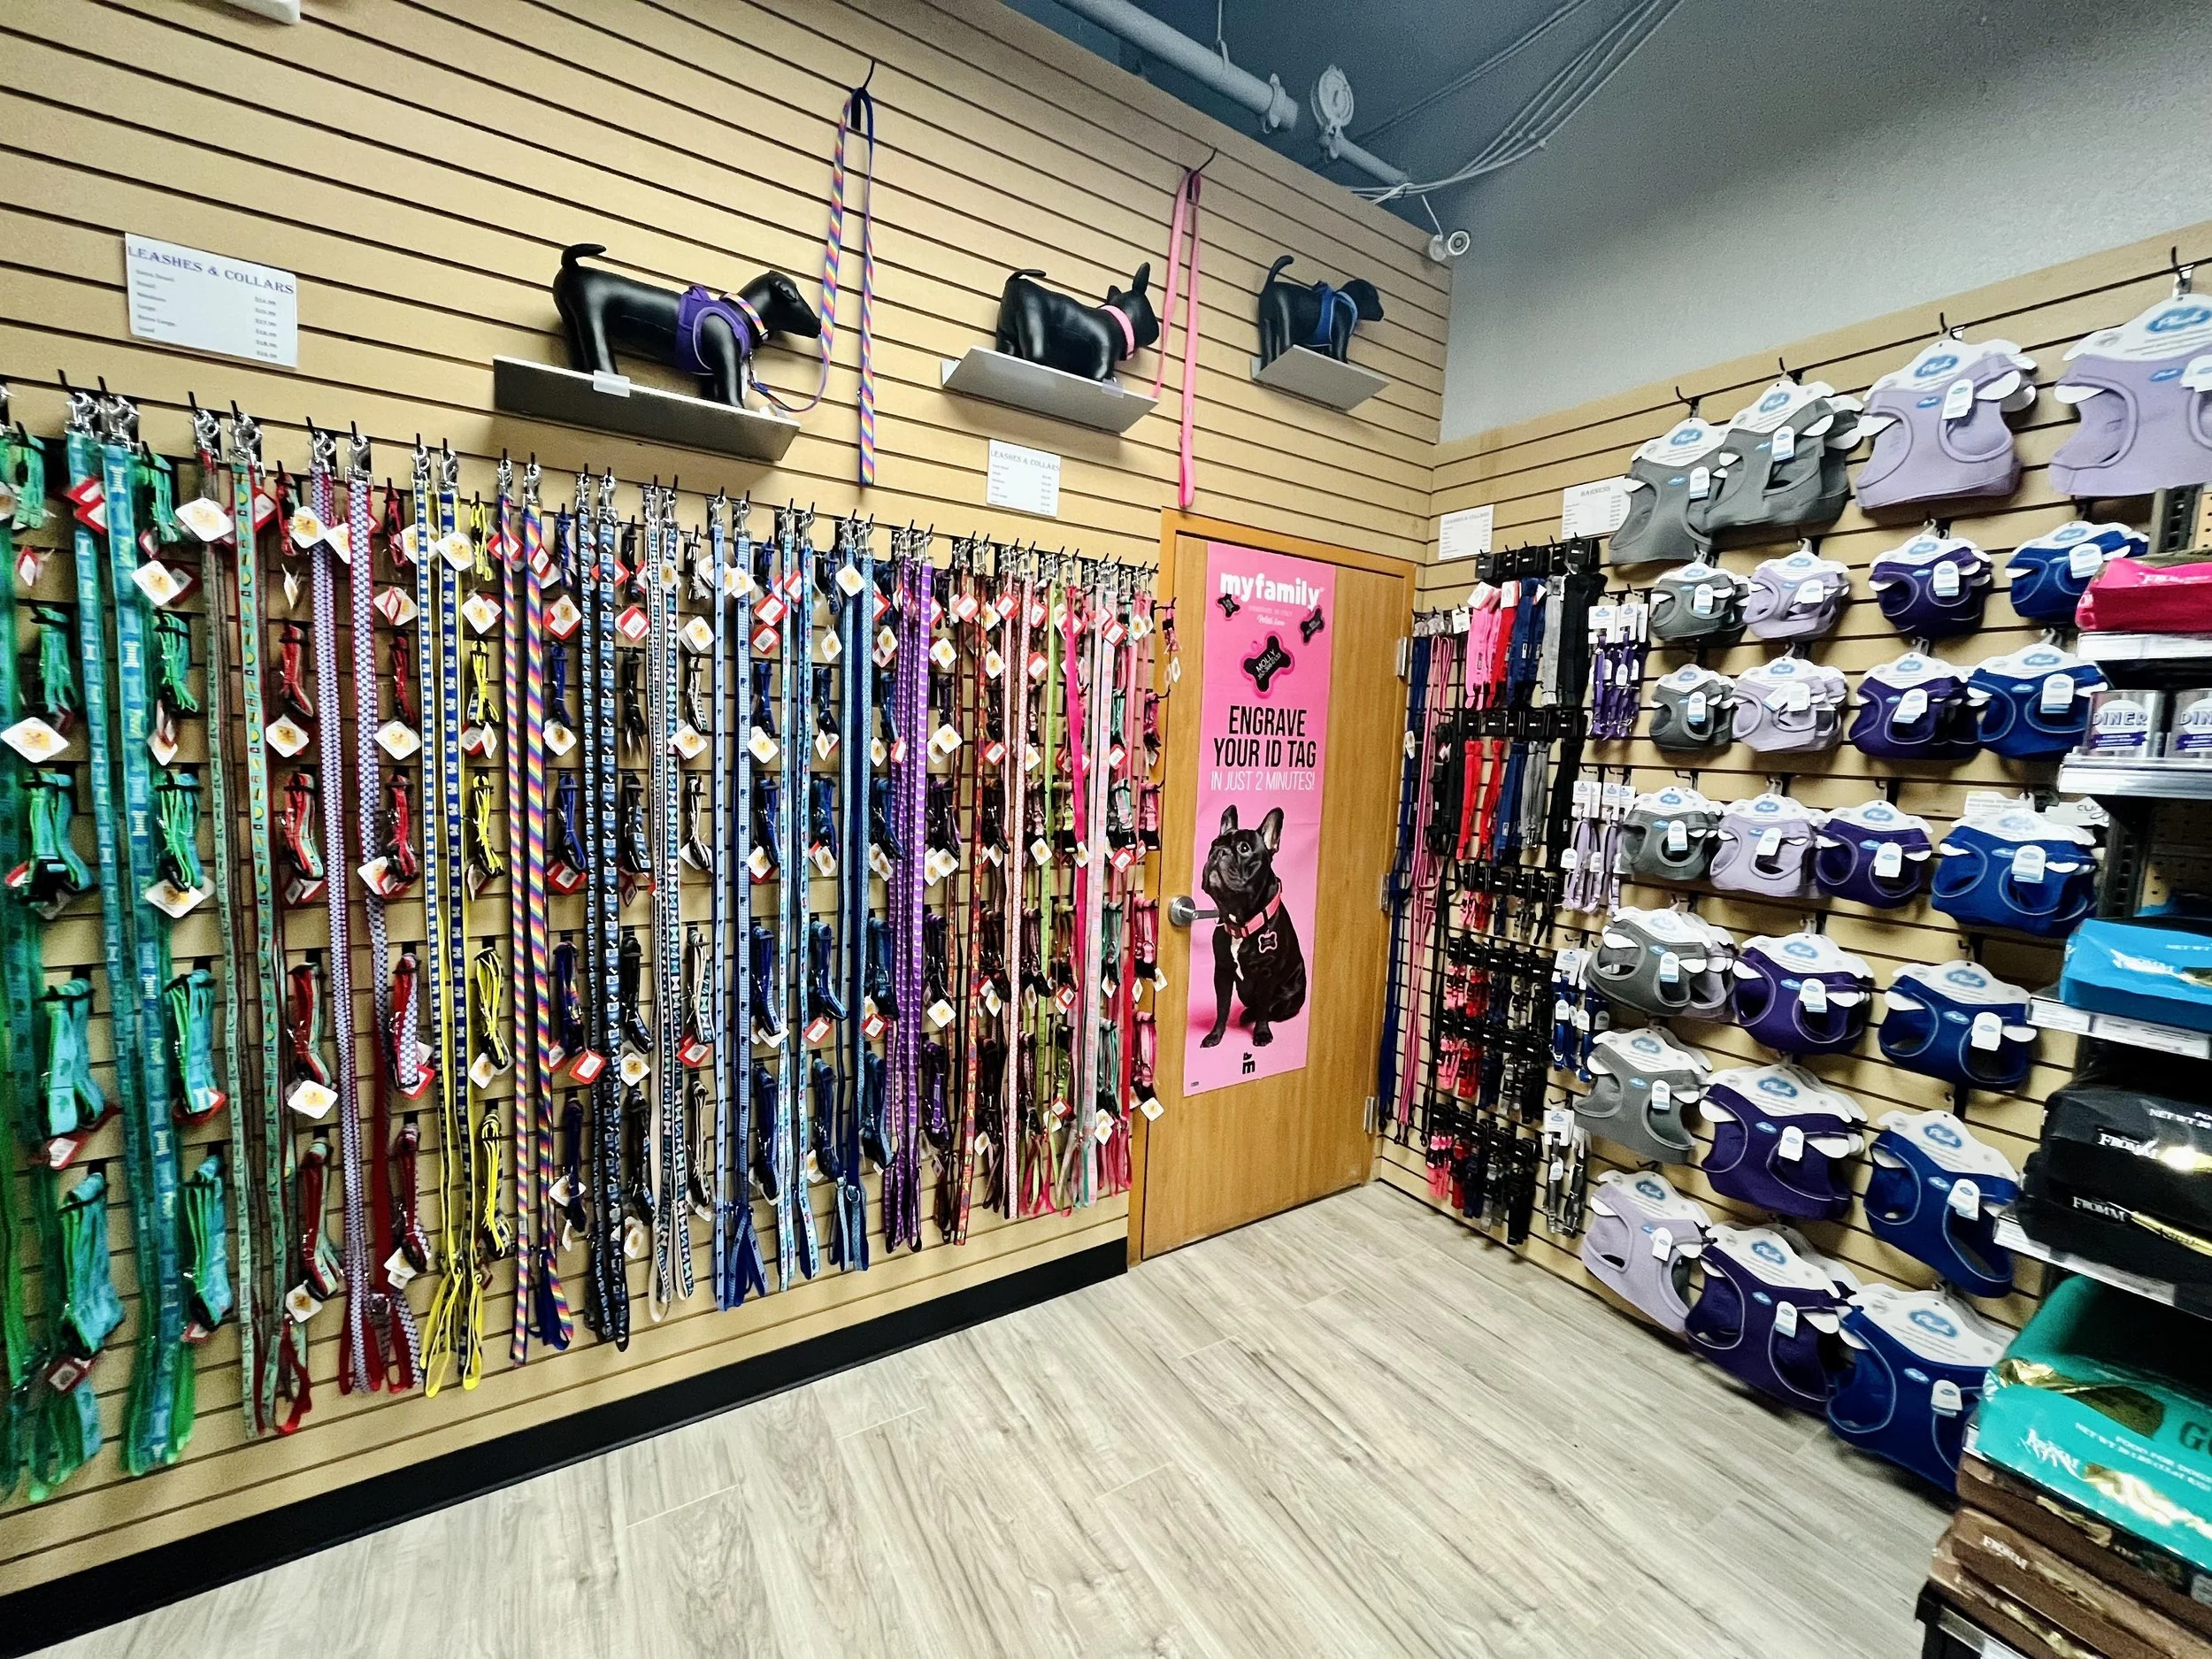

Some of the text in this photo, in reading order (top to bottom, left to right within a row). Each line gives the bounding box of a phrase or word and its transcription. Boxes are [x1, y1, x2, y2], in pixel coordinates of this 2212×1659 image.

[127, 245, 295, 295] LEASHES & COLLARS
[990, 449, 1022, 463] LEASHES
[1030, 459, 1061, 472] COLLARS
[1220, 572, 1320, 612] myfamily
[1256, 649, 1276, 672] MOLLY
[1228, 705, 1307, 737] ENGRAVE
[2093, 711, 2148, 726] DINER
[1213, 737, 1317, 768] YOUR ID TAG
[1210, 771, 1316, 791] IN JUST 2 MINUTES!
[2072, 1195, 2127, 1222] FROMM
